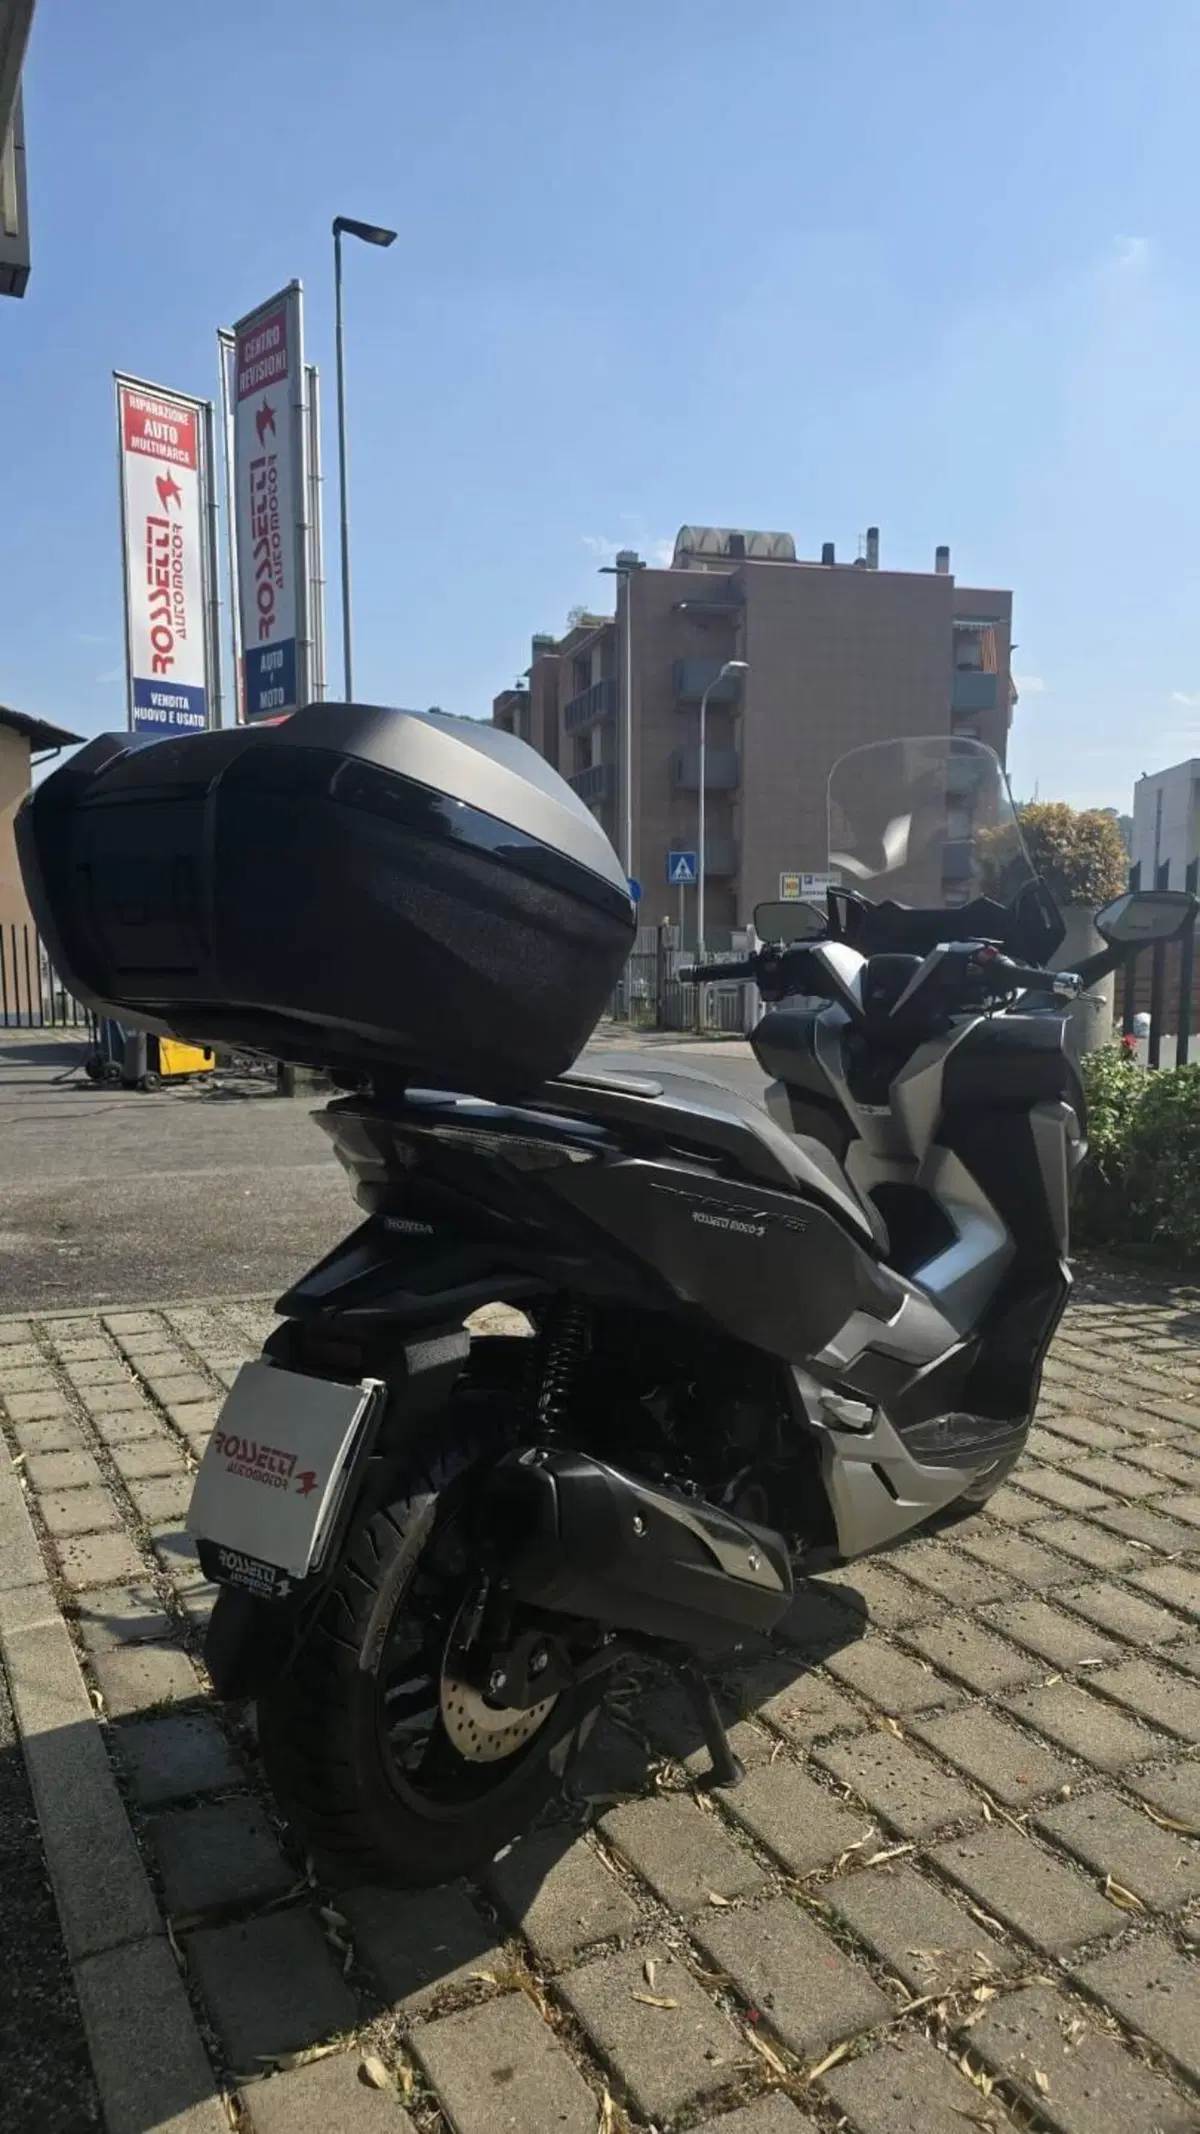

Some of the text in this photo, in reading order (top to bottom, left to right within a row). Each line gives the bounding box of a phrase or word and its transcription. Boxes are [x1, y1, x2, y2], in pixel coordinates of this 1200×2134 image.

[244, 324, 280, 363] CENTRO
[239, 347, 287, 393] REVISIONI
[128, 395, 190, 427] RIPARAZIONE
[143, 418, 180, 445] AUTO
[130, 435, 190, 463] MULTIMARCA
[249, 456, 275, 641] ROSSETTI
[146, 515, 175, 675] ROSSETTI
[172, 522, 187, 641] AUTOMOTOR
[260, 650, 284, 673] AUTO
[150, 692, 190, 711] VENDITA
[260, 686, 285, 709] MOTO
[134, 706, 205, 727] NUOVO E USATO
[386, 1218, 435, 1235] HONDA
[214, 1431, 298, 1478] ROSSETTI
[219, 1547, 276, 1584] ROSSETTI
